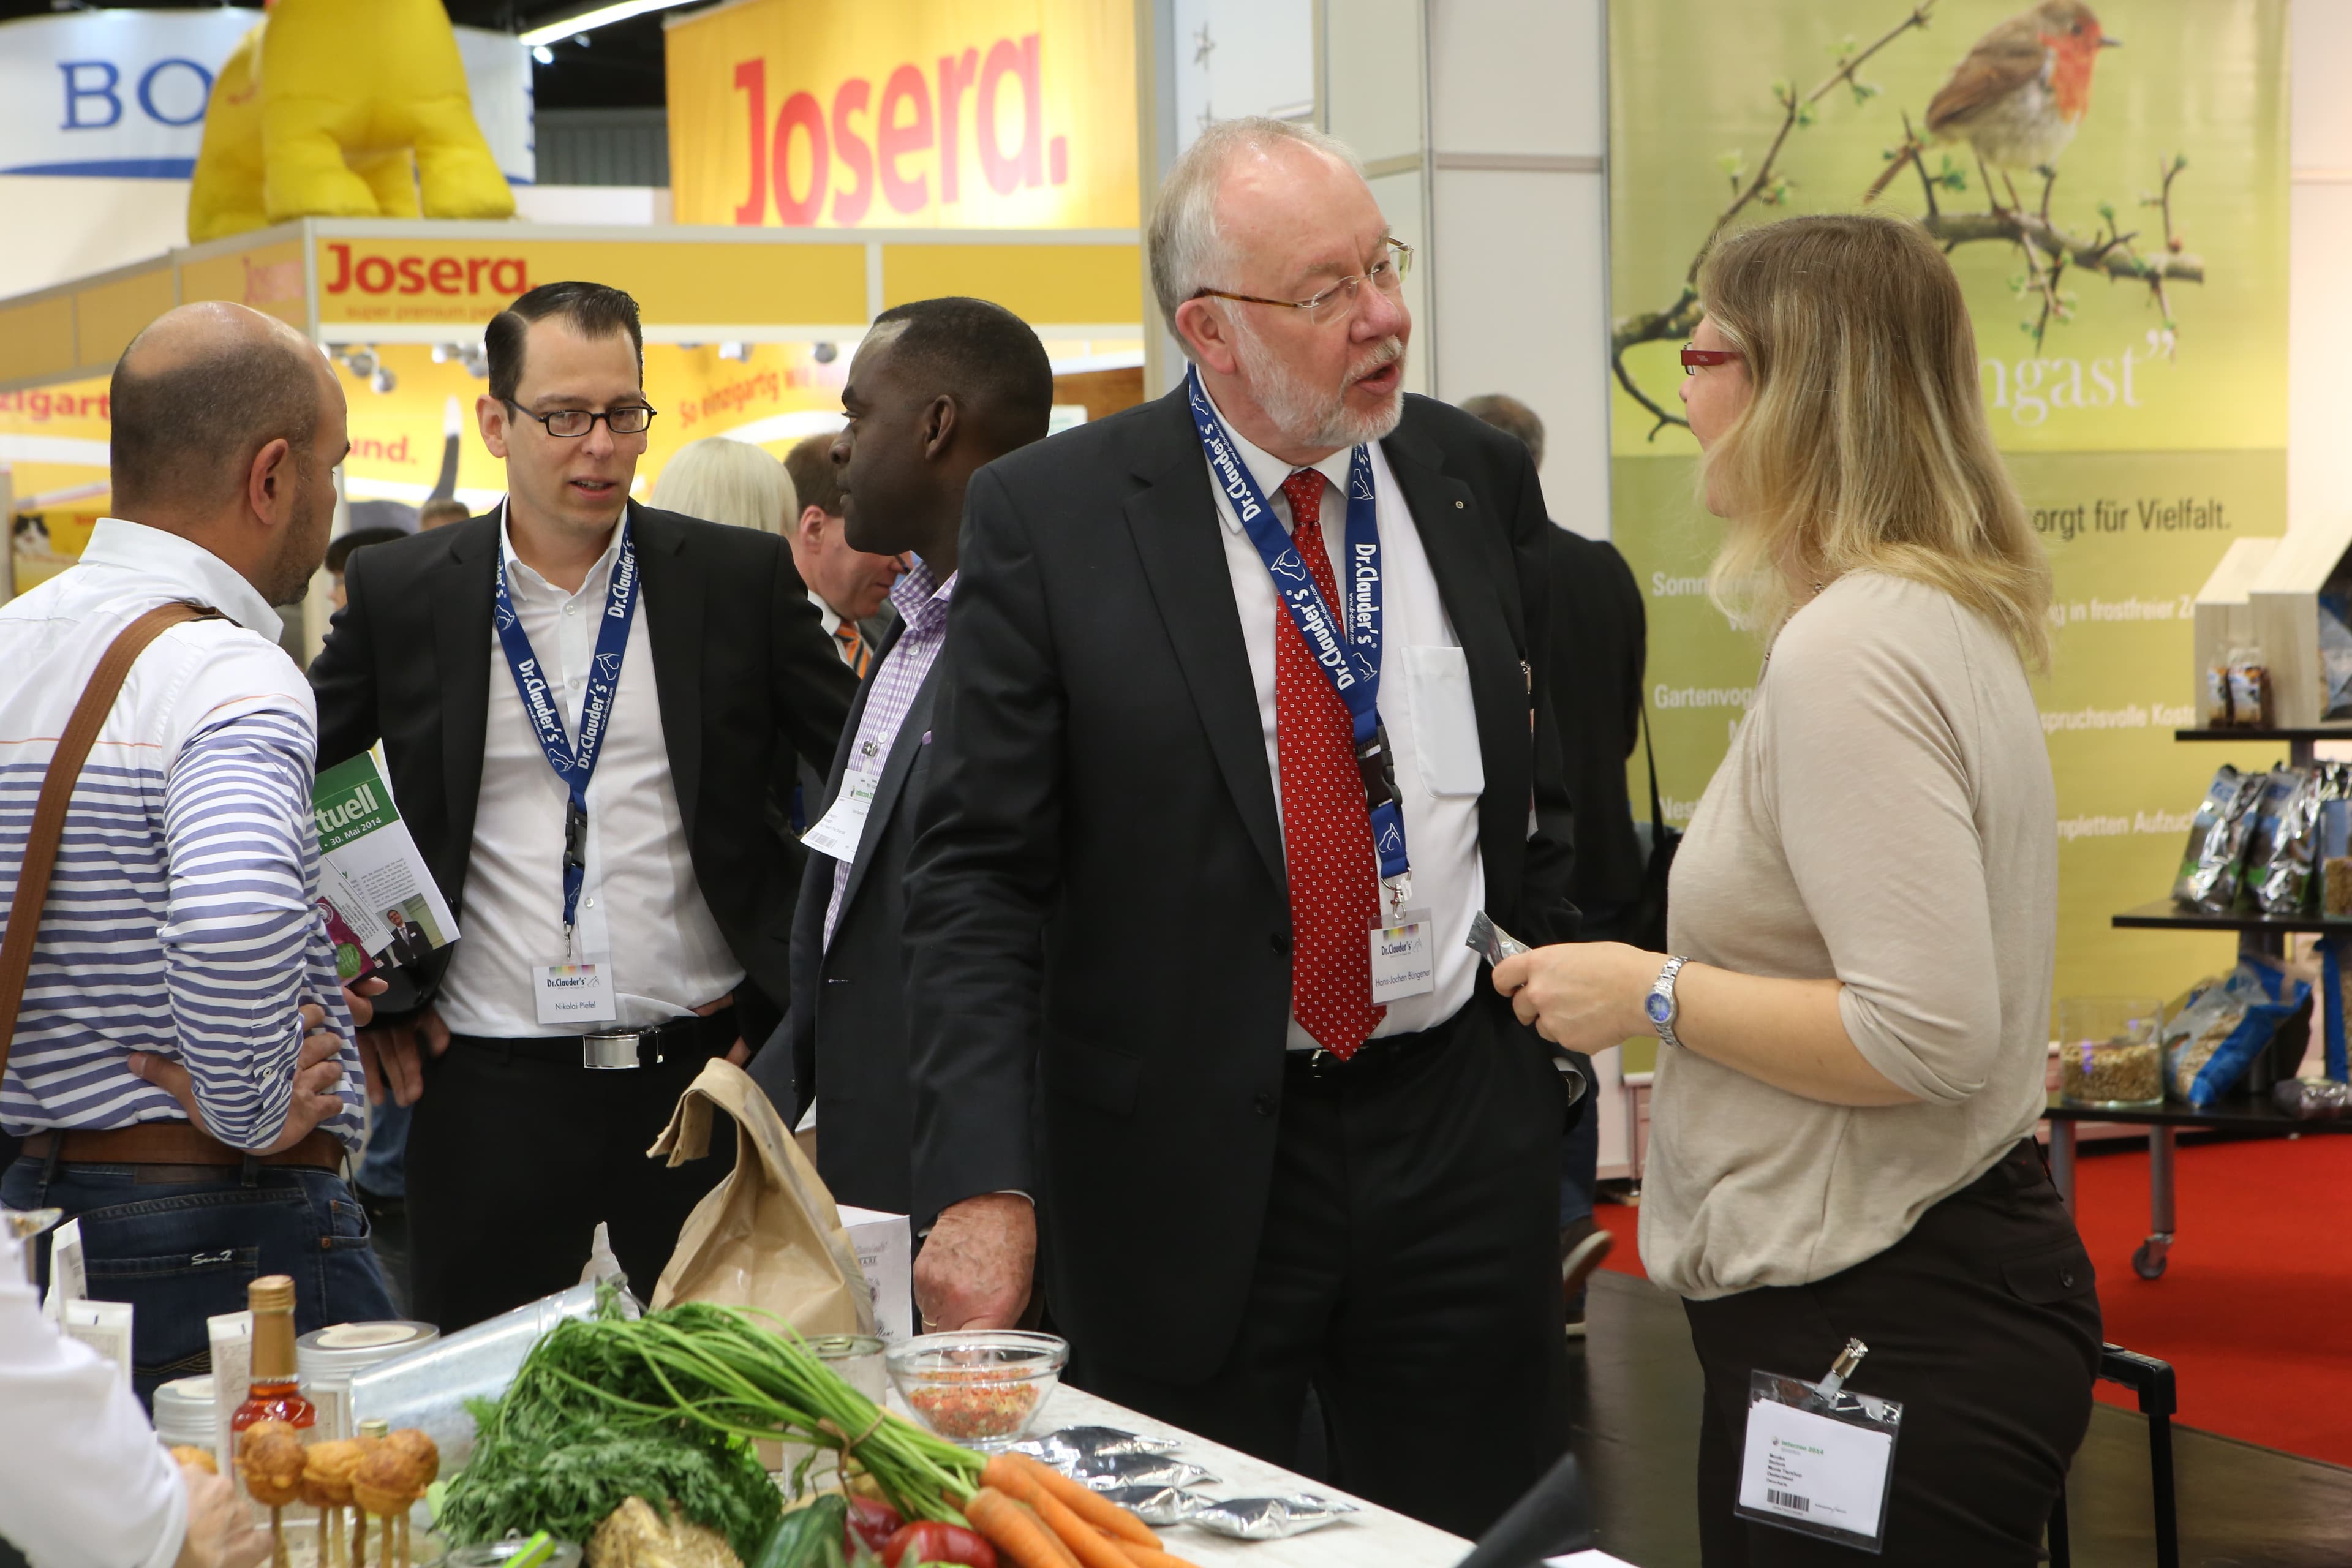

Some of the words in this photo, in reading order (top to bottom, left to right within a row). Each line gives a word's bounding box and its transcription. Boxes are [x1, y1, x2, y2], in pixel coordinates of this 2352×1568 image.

[57, 58, 214, 130] BO
[734, 32, 1068, 228] Josera.
[0, 389, 110, 421] zigart
[1980, 329, 2174, 428] ngast”
[1204, 423, 1263, 522] Dr.Clauder's
[2034, 503, 2086, 540] orgt
[2094, 498, 2130, 532] für
[2137, 496, 2232, 531] Vielfalt.
[607, 540, 635, 619] Dr.Clauder's
[1354, 543, 1379, 644] Dr.Clauder's
[2090, 594, 2174, 622] frostfreier
[1292, 589, 1355, 691] Dr.Clauder's
[518, 658, 562, 742] Dr.Clauder's
[578, 684, 608, 770] Dr.Clauder's
[315, 783, 379, 837] tuell
[330, 835, 344, 846] 30.
[344, 826, 361, 839] Mai
[360, 816, 382, 832] 2014
[547, 978, 584, 987] Dr.Clauder's
[1376, 973, 1407, 987] Hans-Jochen
[1381, 941, 1411, 956] Dr.Clauder's
